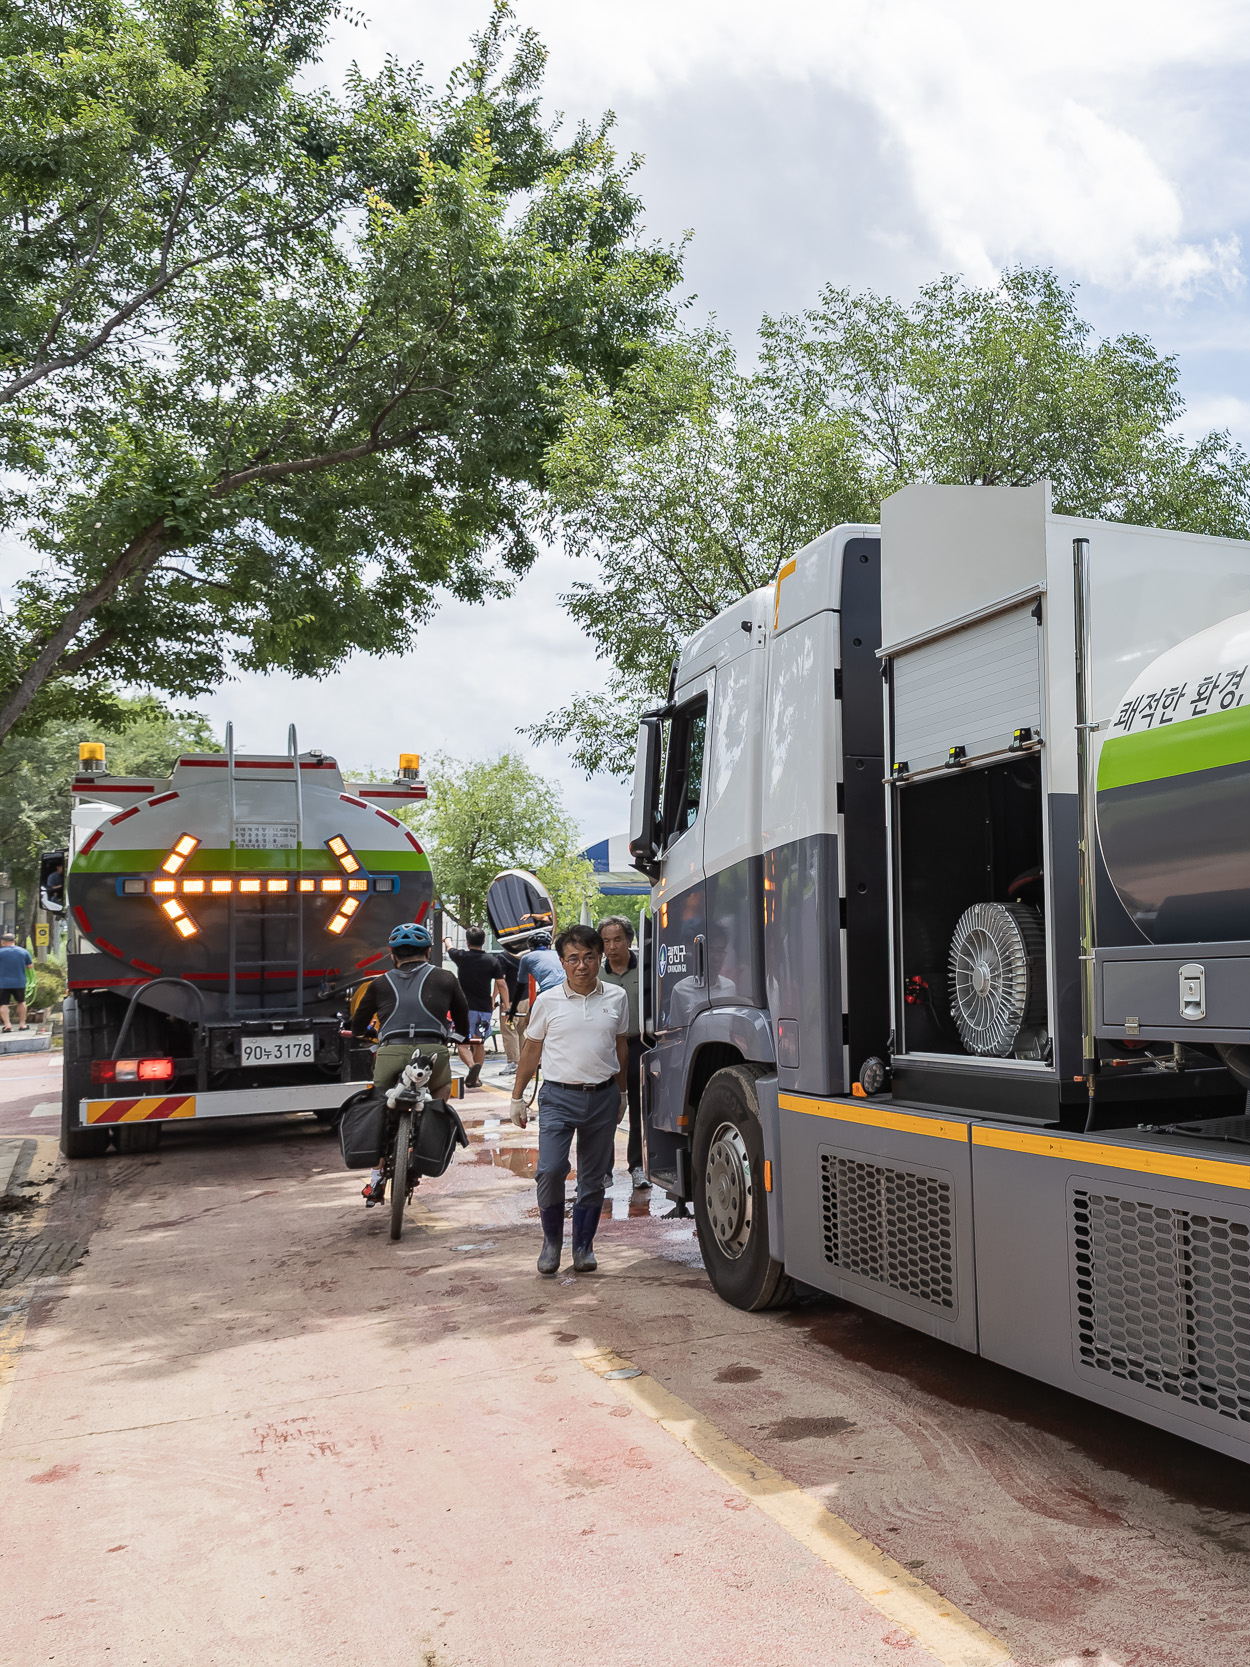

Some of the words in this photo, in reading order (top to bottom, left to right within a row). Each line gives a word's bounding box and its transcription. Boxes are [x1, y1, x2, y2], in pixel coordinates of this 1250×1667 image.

[1112, 682, 1188, 732] 쾌적한
[1190, 664, 1249, 716] 환경,
[668, 945, 686, 964] 광진구
[243, 1042, 313, 1061] 90누3178
